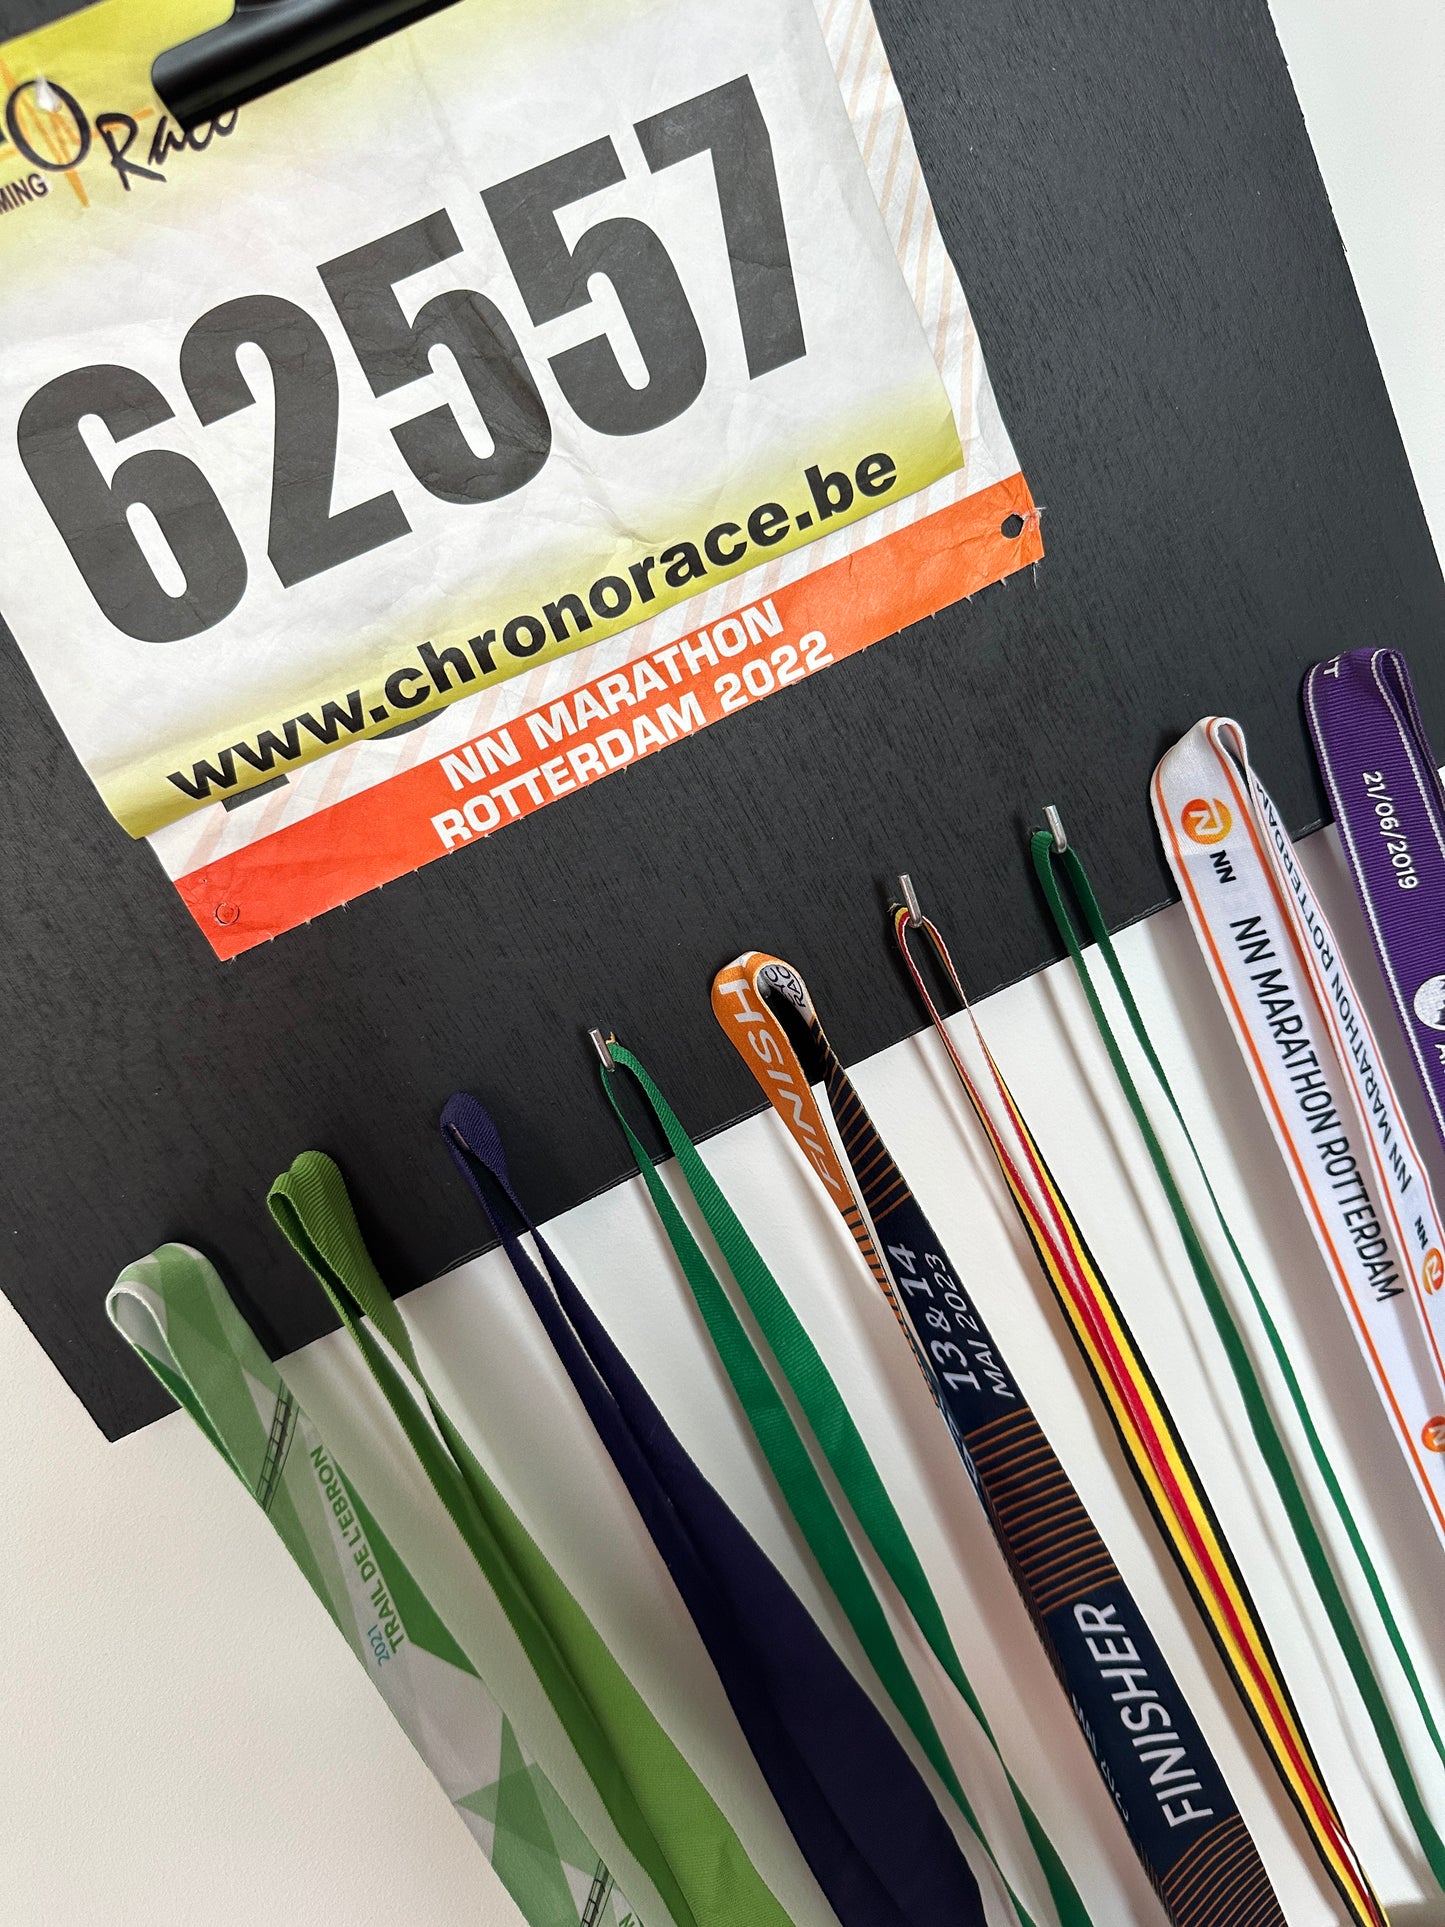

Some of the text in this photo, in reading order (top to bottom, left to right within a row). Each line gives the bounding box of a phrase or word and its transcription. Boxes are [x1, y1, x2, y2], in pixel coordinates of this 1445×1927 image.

[17, 74, 806, 643] 62557
[167, 452, 897, 800] www.chronorace.be
[432, 630, 834, 849] ROTTERDAM 2022
[439, 599, 784, 791] NN MARATHON
[1210, 850, 1237, 883] NN
[1362, 771, 1418, 889] 21/06/2019
[1257, 781, 1411, 1192] NN MARATHON ROTTERDAM
[1230, 916, 1404, 1302] NN MARATHON ROTTERDAM
[889, 1244, 934, 1298] 14
[1414, 1215, 1427, 1249] NN
[925, 1252, 980, 1334] 2023
[925, 1306, 952, 1333] &
[930, 1339, 981, 1392] 13
[967, 1338, 1016, 1399] MAI
[310, 1444, 405, 1654] TRAIL DE L'EBRON
[367, 1625, 390, 1666] 2021
[1073, 1602, 1213, 1827] FINISHER
